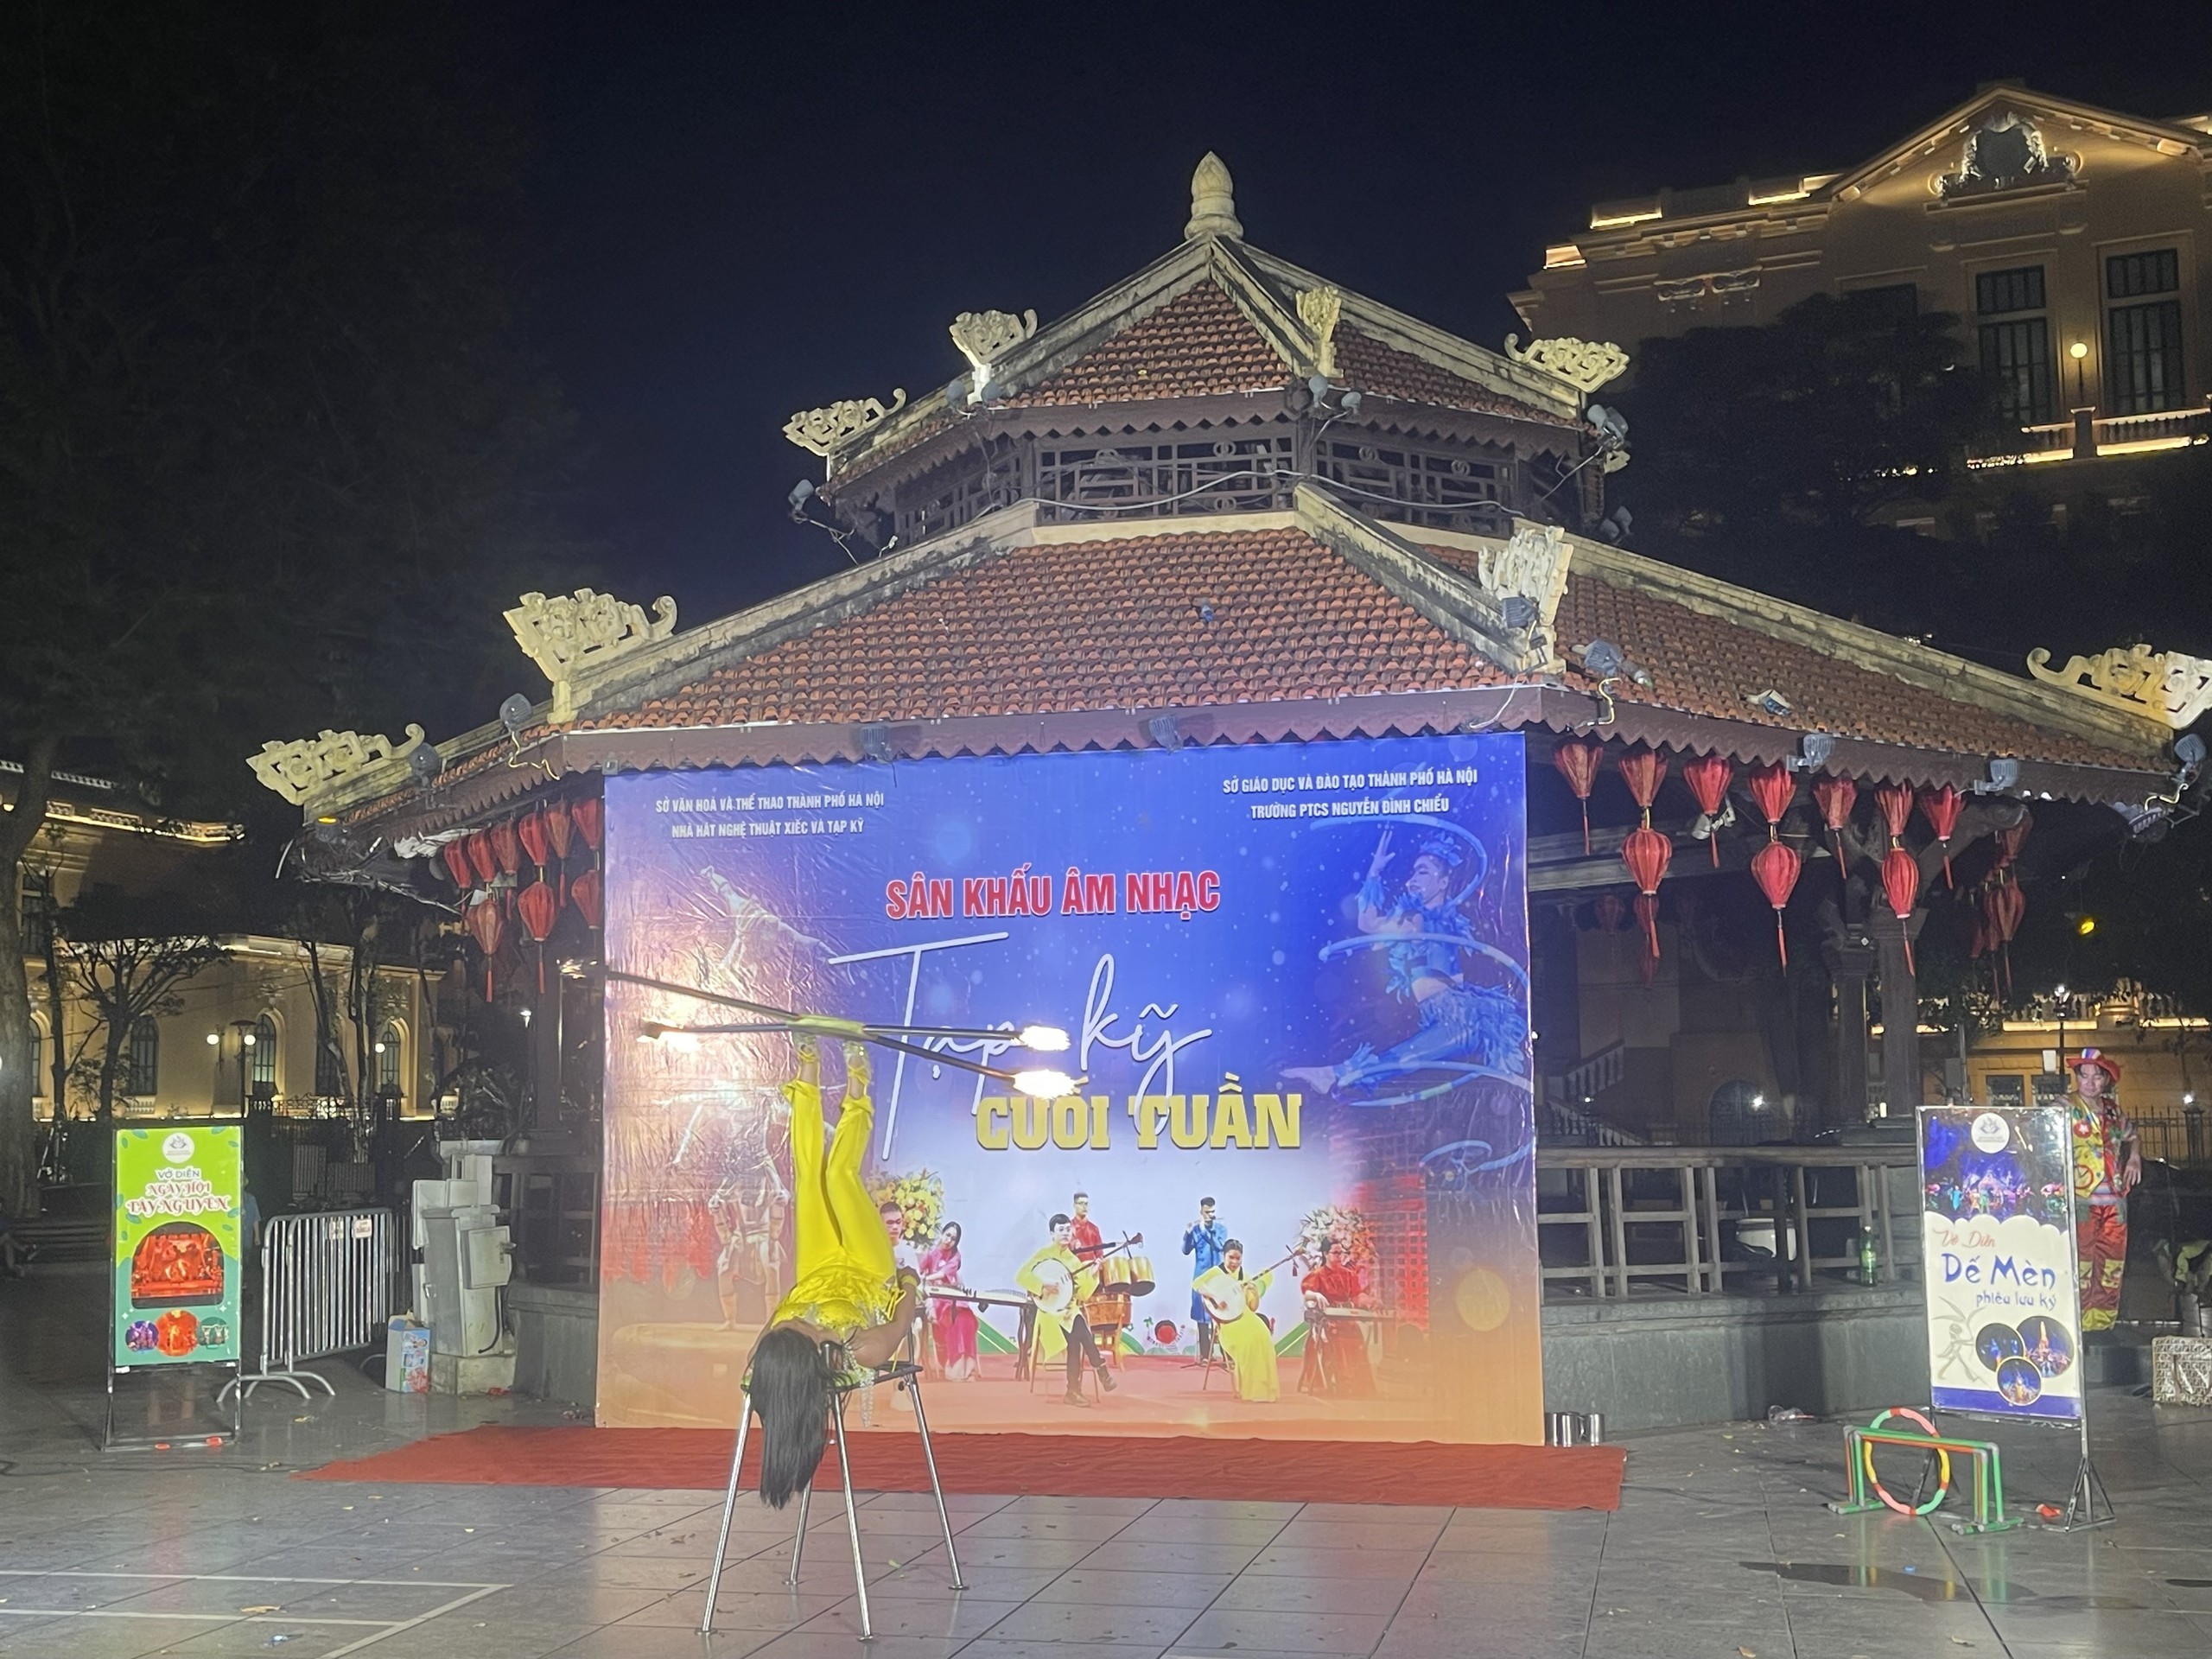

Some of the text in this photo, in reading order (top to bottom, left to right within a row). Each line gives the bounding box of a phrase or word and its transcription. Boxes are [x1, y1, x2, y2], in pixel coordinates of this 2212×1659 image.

[1223, 766, 1478, 794] SỞ GIÁO DỤC VÀ ĐÀO TẠO THÀNH PHỐ HÀ NỘI
[656, 790, 884, 812] SỞ VĂN HOÁ VÀ THẾ THAO THÀNH PHỐ HÀ NỘI
[1250, 793, 1449, 819] TRƯỜNG PTCS NGUYỄN ĐÌNH CHIỂU
[671, 817, 864, 839] NHÀ HÁT NGHỆ THUẬT XIẾC VÀ TẠP KỸ
[886, 862, 1220, 920] SÂN KHẤU ÂM NHẠC
[1080, 953, 1211, 1135] kỹ
[1128, 1071, 1302, 1149] TUẦN
[1941, 1253, 2056, 1289] Dế Mèn
[2015, 1291, 2034, 1306] lưu
